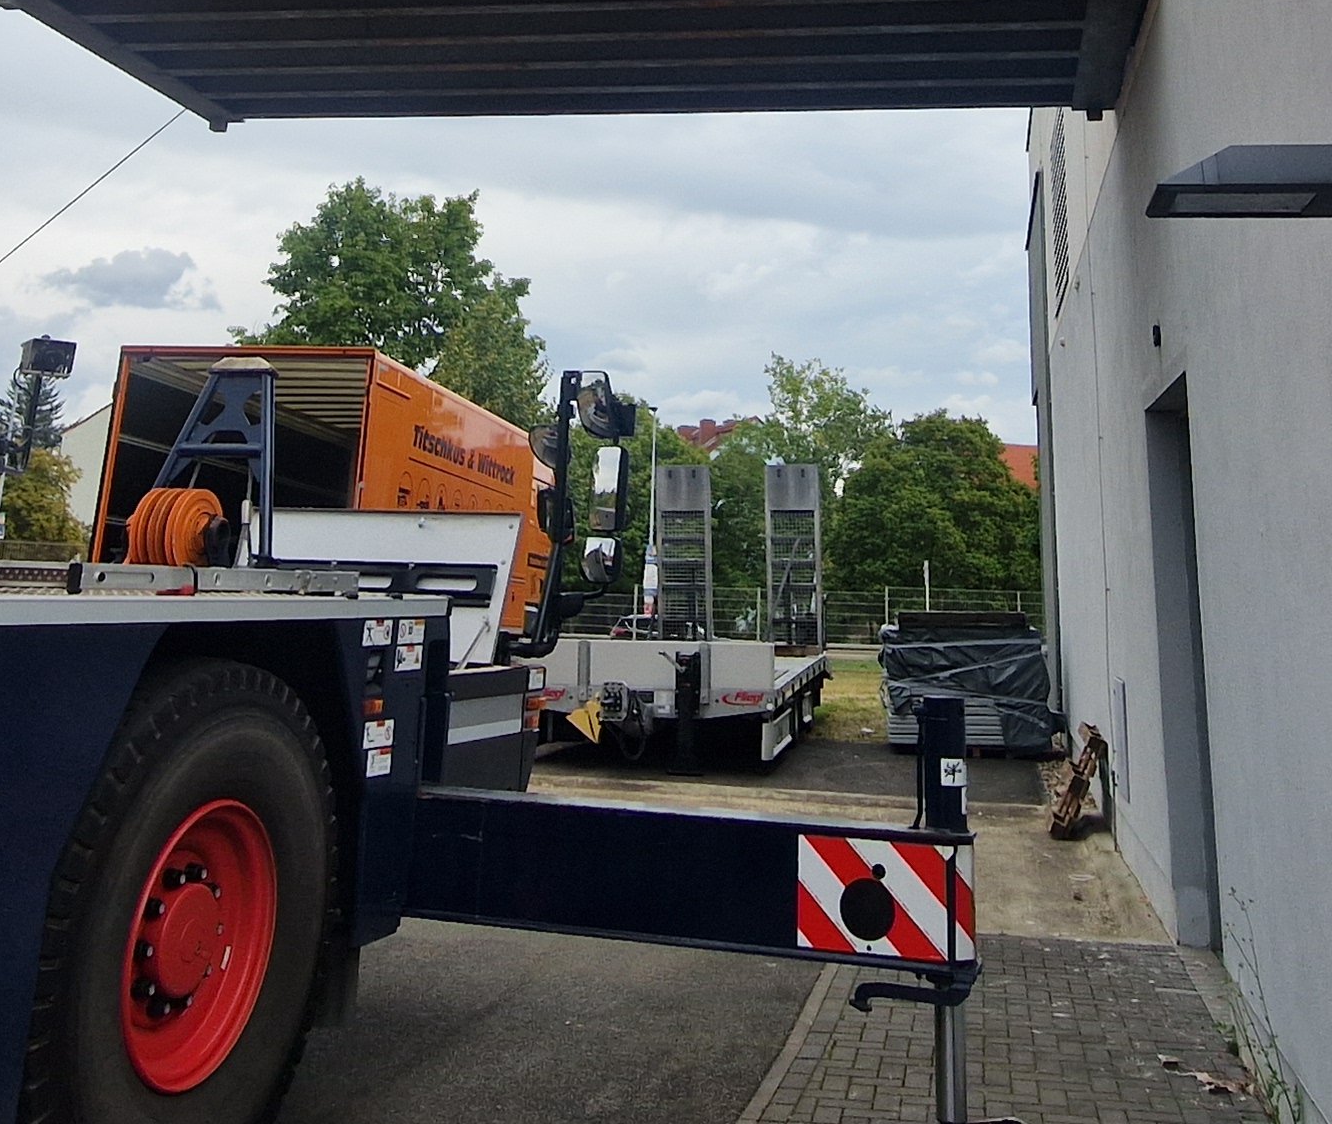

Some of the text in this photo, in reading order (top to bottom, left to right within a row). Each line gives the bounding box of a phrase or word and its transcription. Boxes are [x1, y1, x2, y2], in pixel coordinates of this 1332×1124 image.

[412, 424, 516, 486] Titschkus & Wittrock
